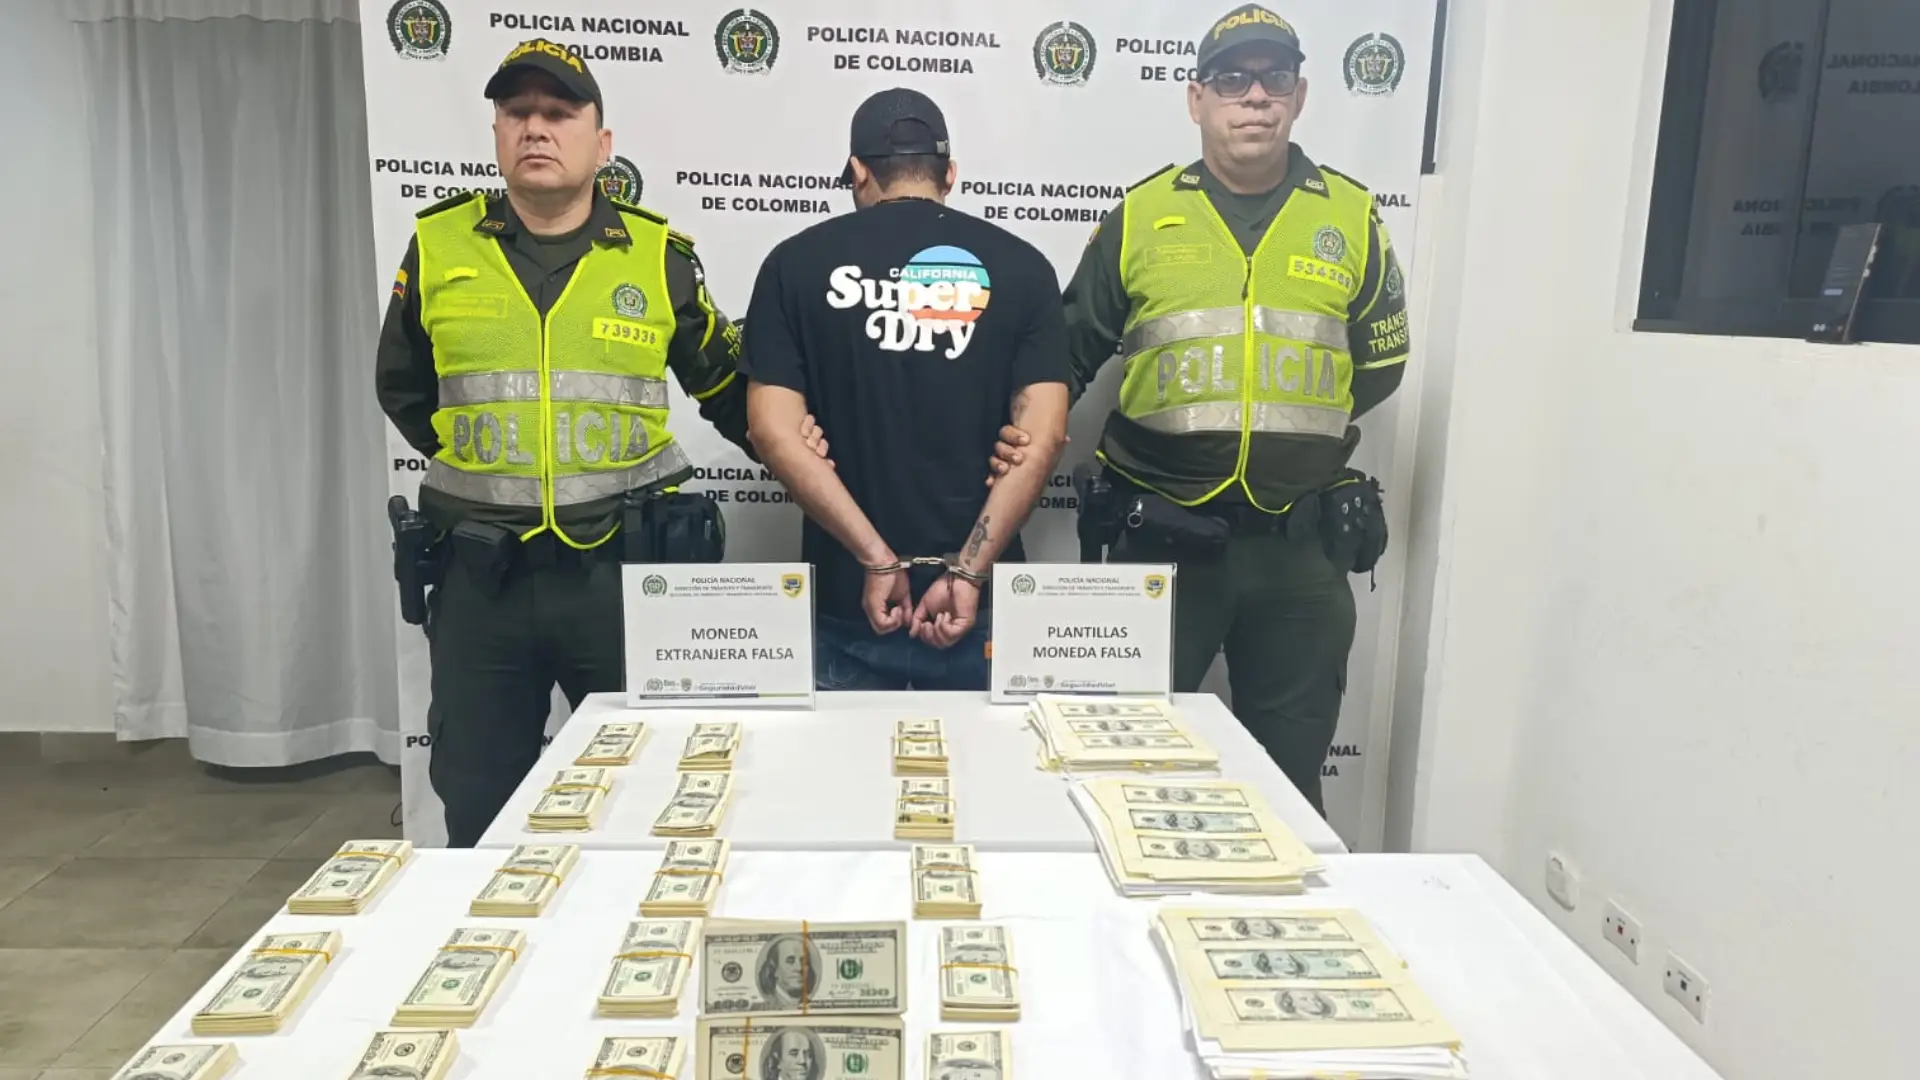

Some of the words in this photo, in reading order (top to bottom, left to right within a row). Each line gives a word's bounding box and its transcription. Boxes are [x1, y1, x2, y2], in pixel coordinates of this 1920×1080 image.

[490, 13, 575, 32] POLICIA
[581, 17, 690, 37] NACIONAL
[807, 26, 889, 43] POLICIA
[895, 29, 1001, 48] NACIONAL
[558, 43, 664, 63] OLOMBIA
[1116, 38, 1197, 56] POLICIA
[834, 54, 861, 70] DE
[866, 55, 974, 74] COLOMBIA
[1140, 66, 1167, 82] DE
[375, 158, 455, 176] POLICIA
[676, 171, 753, 187] POLICIA
[401, 184, 428, 199] DE
[961, 181, 1036, 197] POLICIA
[1041, 183, 1125, 200] NACIONA
[701, 197, 726, 211] DE
[732, 197, 831, 214] COLOMBIA
[984, 205, 1009, 220] DE
[889, 267, 979, 282] CALIFORNIA
[826, 265, 983, 314] Super
[865, 309, 976, 360] Dry
[693, 467, 755, 482] OLICIA
[705, 489, 729, 503] DE
[691, 627, 758, 640] MONEDA
[1047, 626, 1128, 639] PLANTILLAS
[655, 648, 748, 661] EXTRANJERA
[751, 647, 795, 660] FALSA
[1032, 646, 1097, 659] MONEDA
[1101, 646, 1142, 659] FALSA
